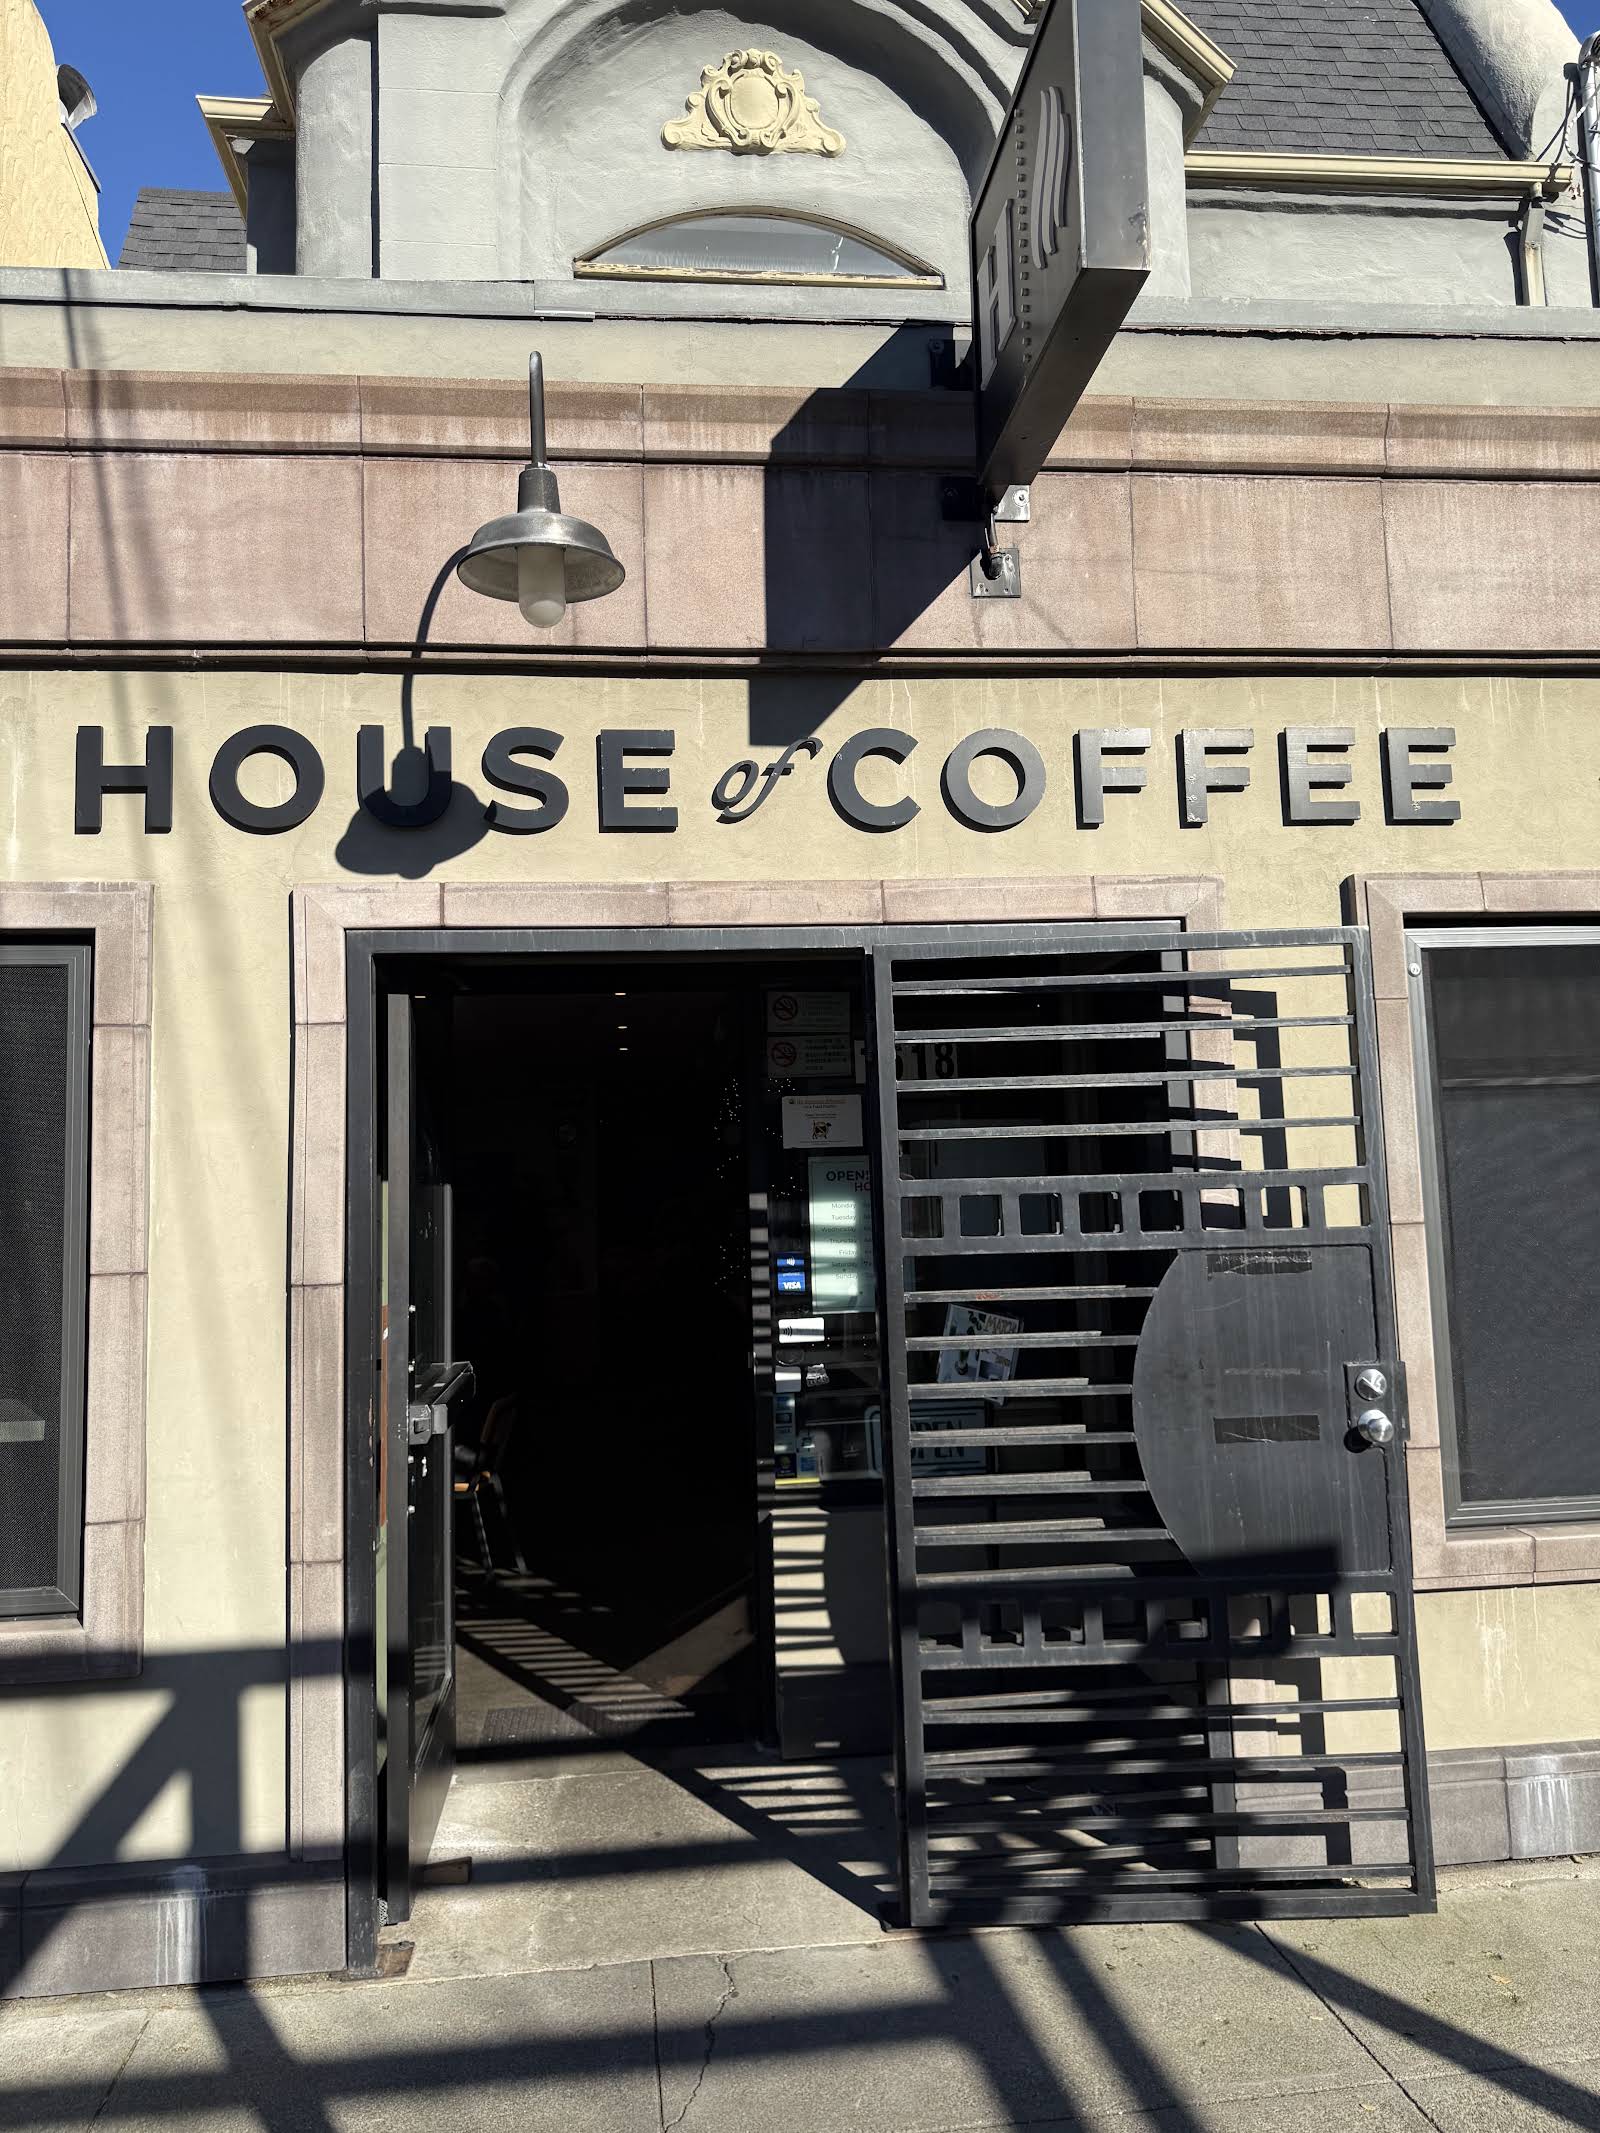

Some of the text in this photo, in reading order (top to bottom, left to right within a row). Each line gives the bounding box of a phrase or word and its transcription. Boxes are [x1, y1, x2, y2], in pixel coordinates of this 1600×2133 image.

[75, 724, 1461, 835] HOUSE of COFFEE
[896, 1043, 954, 1080] 18
[831, 1202, 857, 1210] Monday
[838, 1249, 857, 1257] Friday
[782, 1281, 801, 1289] VISA
[911, 1420, 964, 1458] PEN
